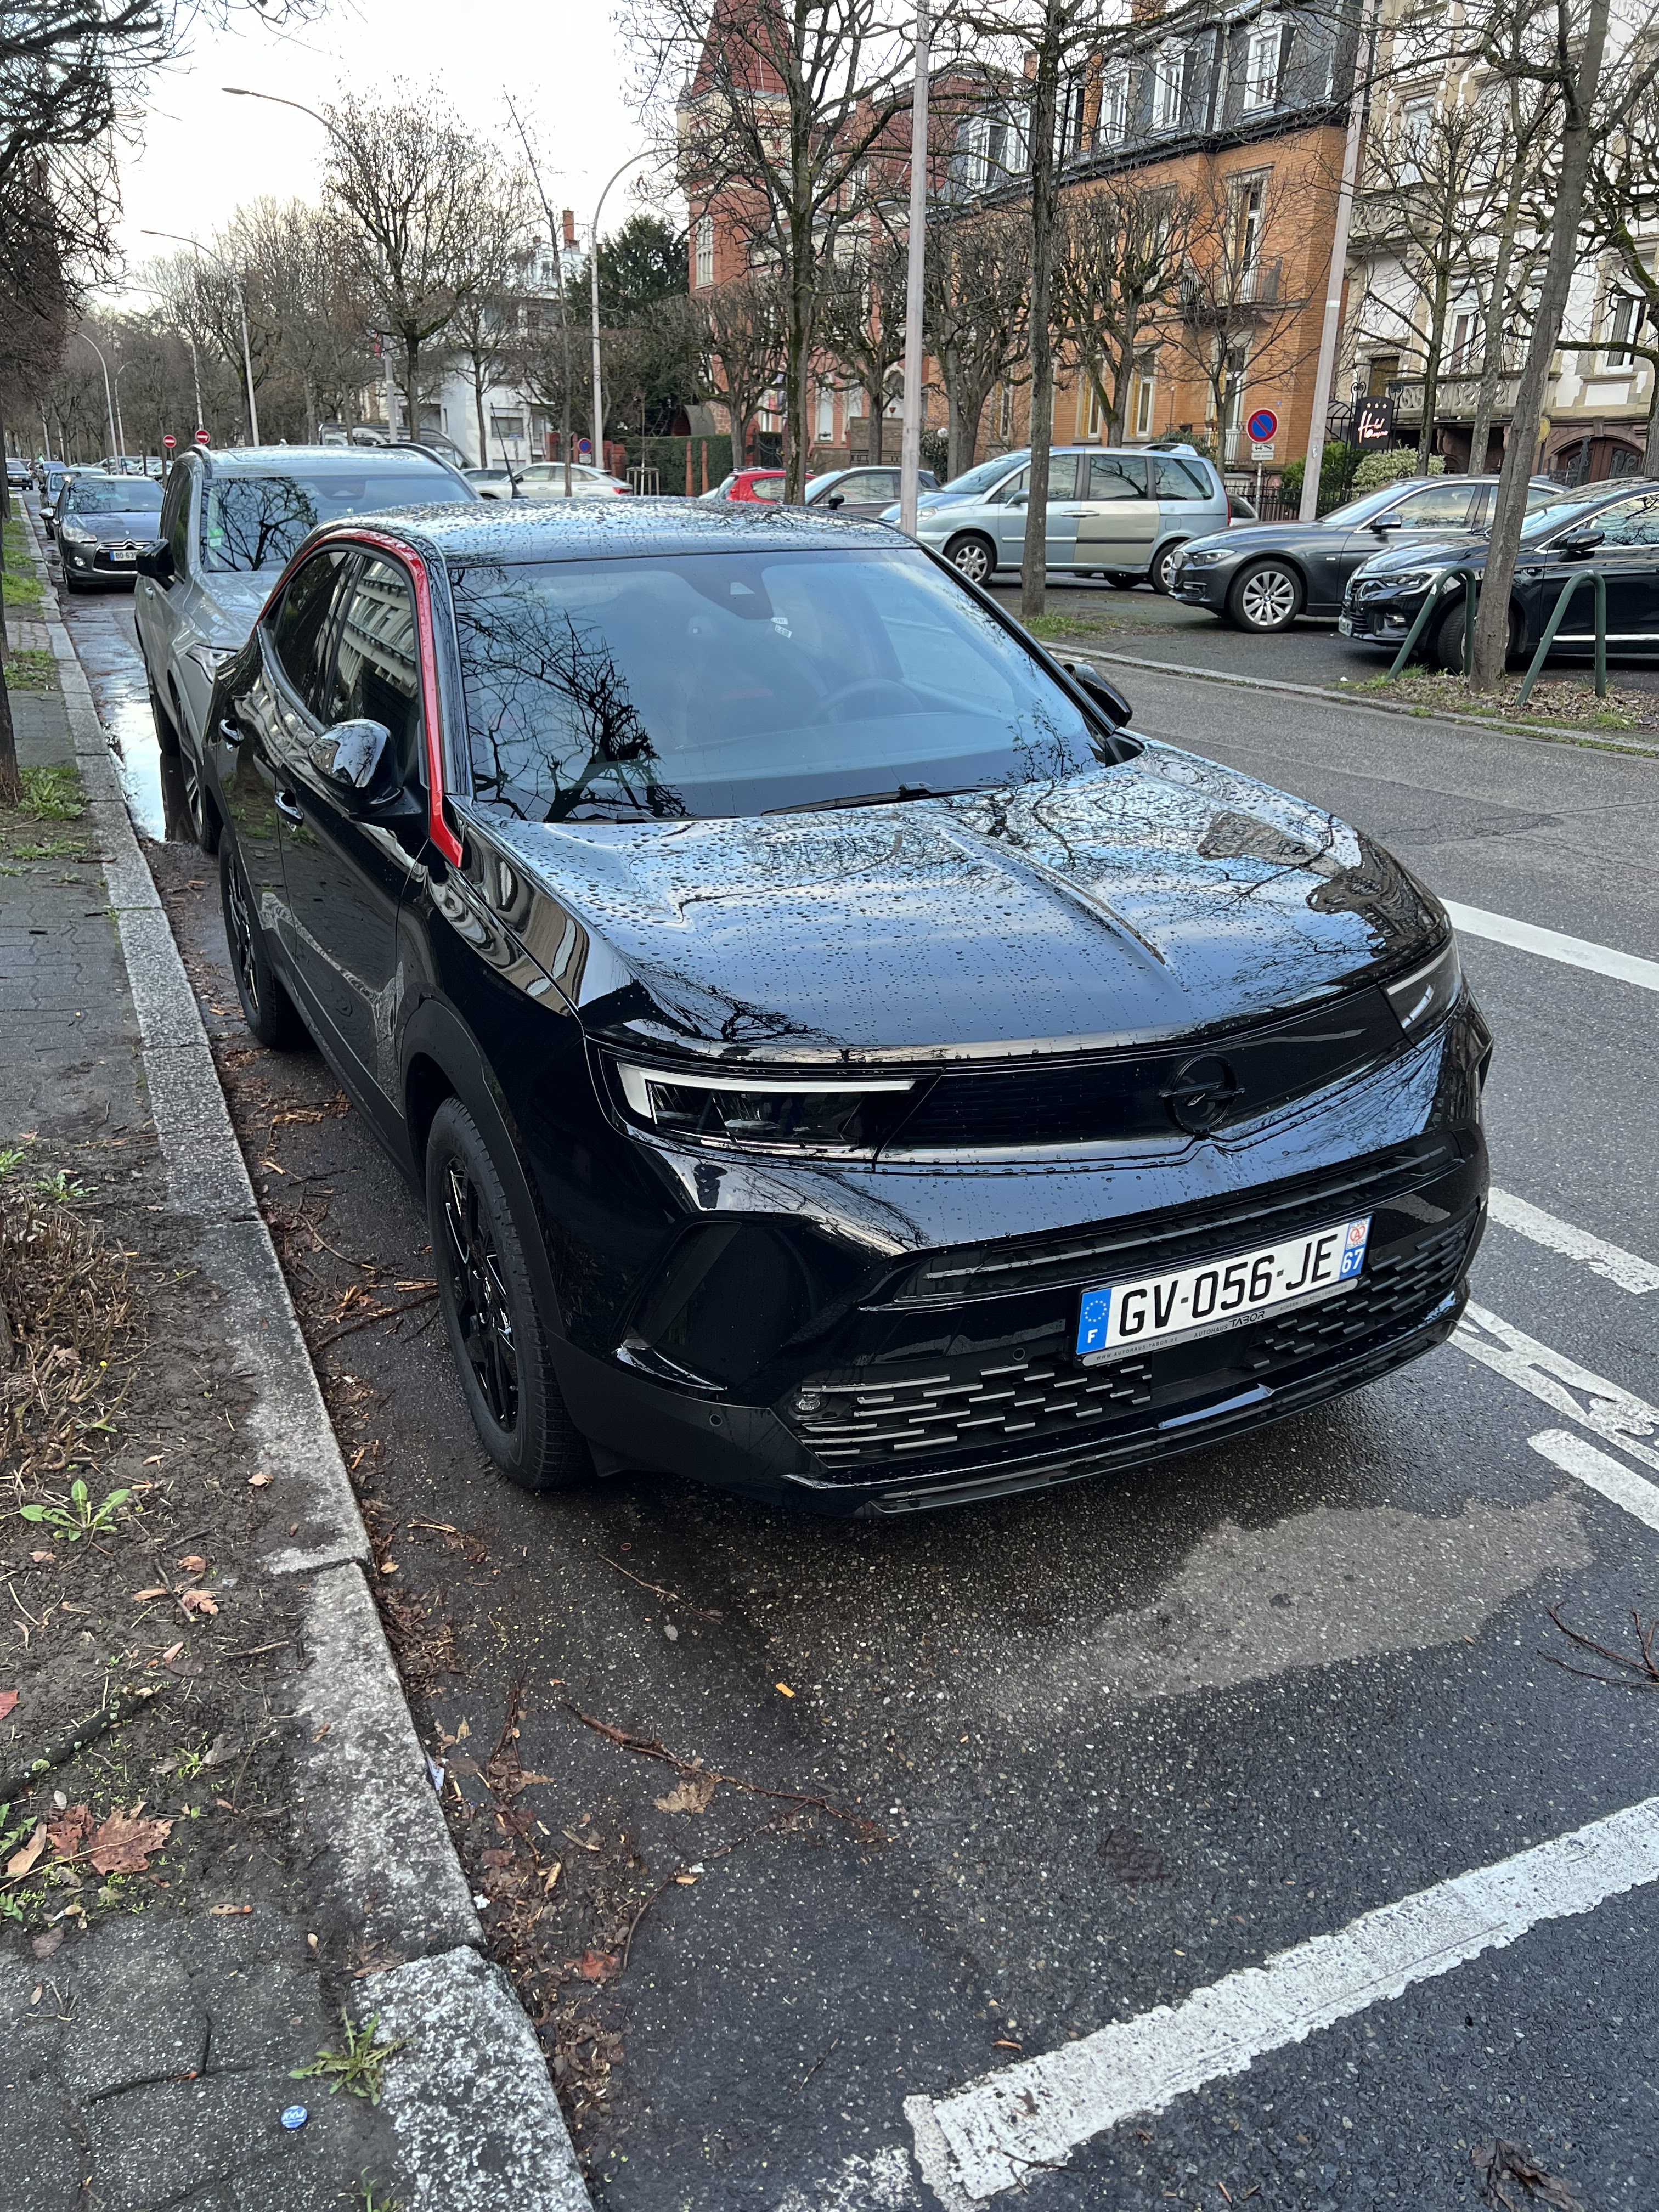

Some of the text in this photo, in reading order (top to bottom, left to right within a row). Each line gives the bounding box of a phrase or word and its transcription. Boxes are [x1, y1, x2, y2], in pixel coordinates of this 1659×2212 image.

[1341, 1247, 1364, 1273] 67
[1119, 1234, 1338, 1336] GV-056-JE
[1087, 1328, 1098, 1344] F
[1193, 1311, 1265, 1339] AUTOHAUS TABOR
